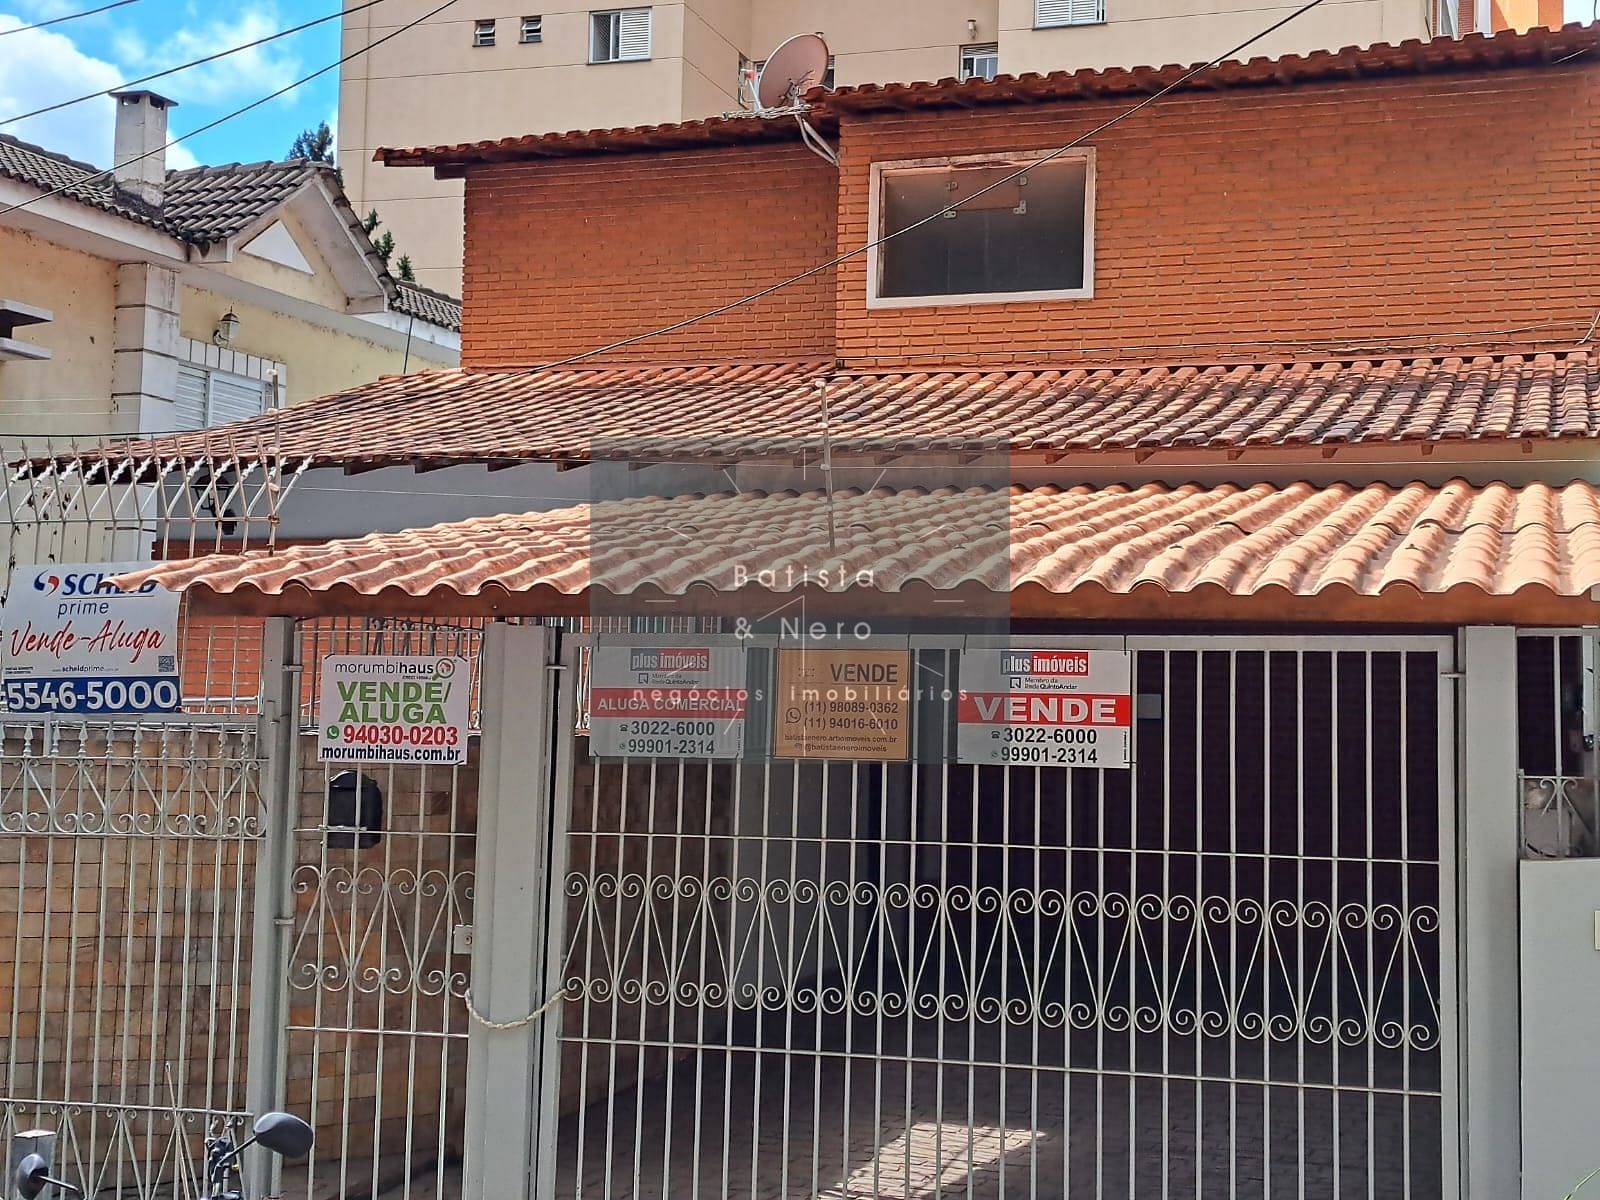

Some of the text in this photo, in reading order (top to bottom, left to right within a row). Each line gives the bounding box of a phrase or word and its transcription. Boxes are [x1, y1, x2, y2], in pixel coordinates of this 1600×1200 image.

[62, 573, 158, 595] SCHD
[58, 600, 109, 619] prime
[11, 619, 166, 664] Vende-Aluga
[335, 658, 434, 674] morumbihaus
[632, 652, 708, 670] plus imóveis
[1002, 655, 1087, 675] plus imóveis
[830, 663, 898, 682] VENDE
[7, 681, 178, 710] 5546-5000
[337, 681, 452, 704] VENDE/
[338, 702, 447, 724] ALUGA
[597, 698, 745, 712] ALUGA COMERCIAL
[804, 701, 898, 715] (11) 98089-0362
[974, 696, 1117, 723] VENDE
[631, 720, 715, 736] 3022-6000
[804, 717, 898, 731] (11) 94016-6010
[343, 724, 458, 746] 94030-0203
[1003, 727, 1098, 744] 3022-6000
[322, 745, 461, 761] morumbihaus.com.br
[628, 739, 715, 755] 99901-2314
[1001, 746, 1098, 763] 99901-2314
